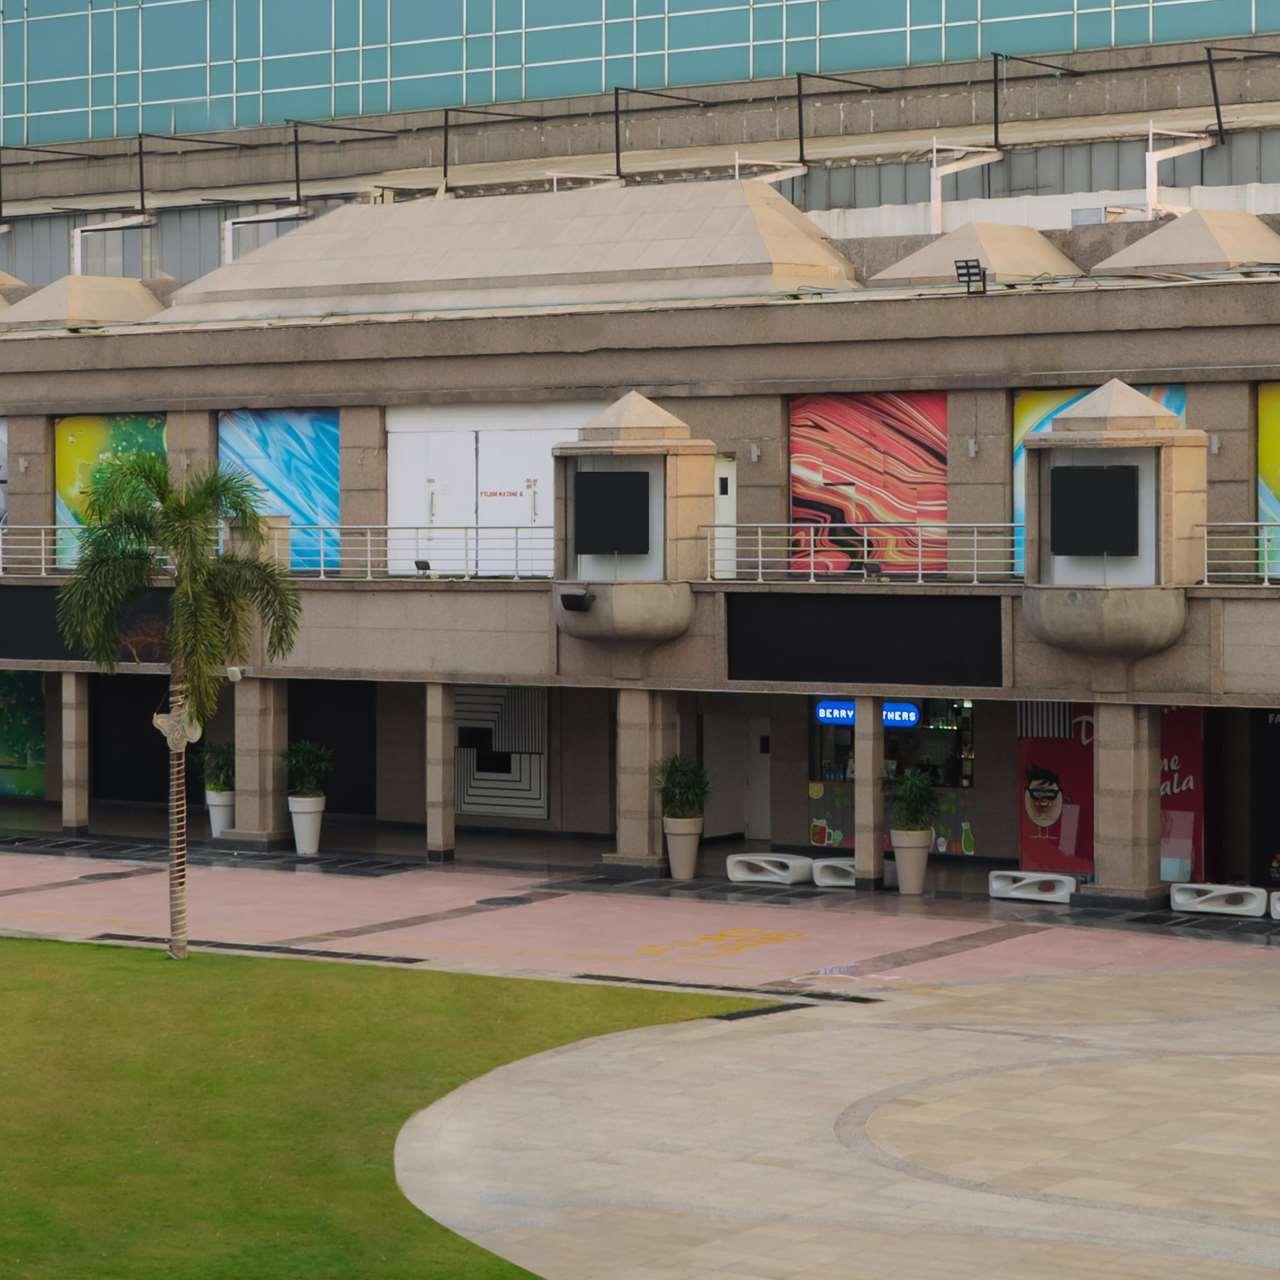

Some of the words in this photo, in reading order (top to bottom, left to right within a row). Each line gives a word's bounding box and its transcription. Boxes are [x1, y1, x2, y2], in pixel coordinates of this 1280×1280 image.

[818, 708, 854, 719] BERRY
[882, 710, 917, 721] THERS
[1160, 773, 1195, 796] ala
